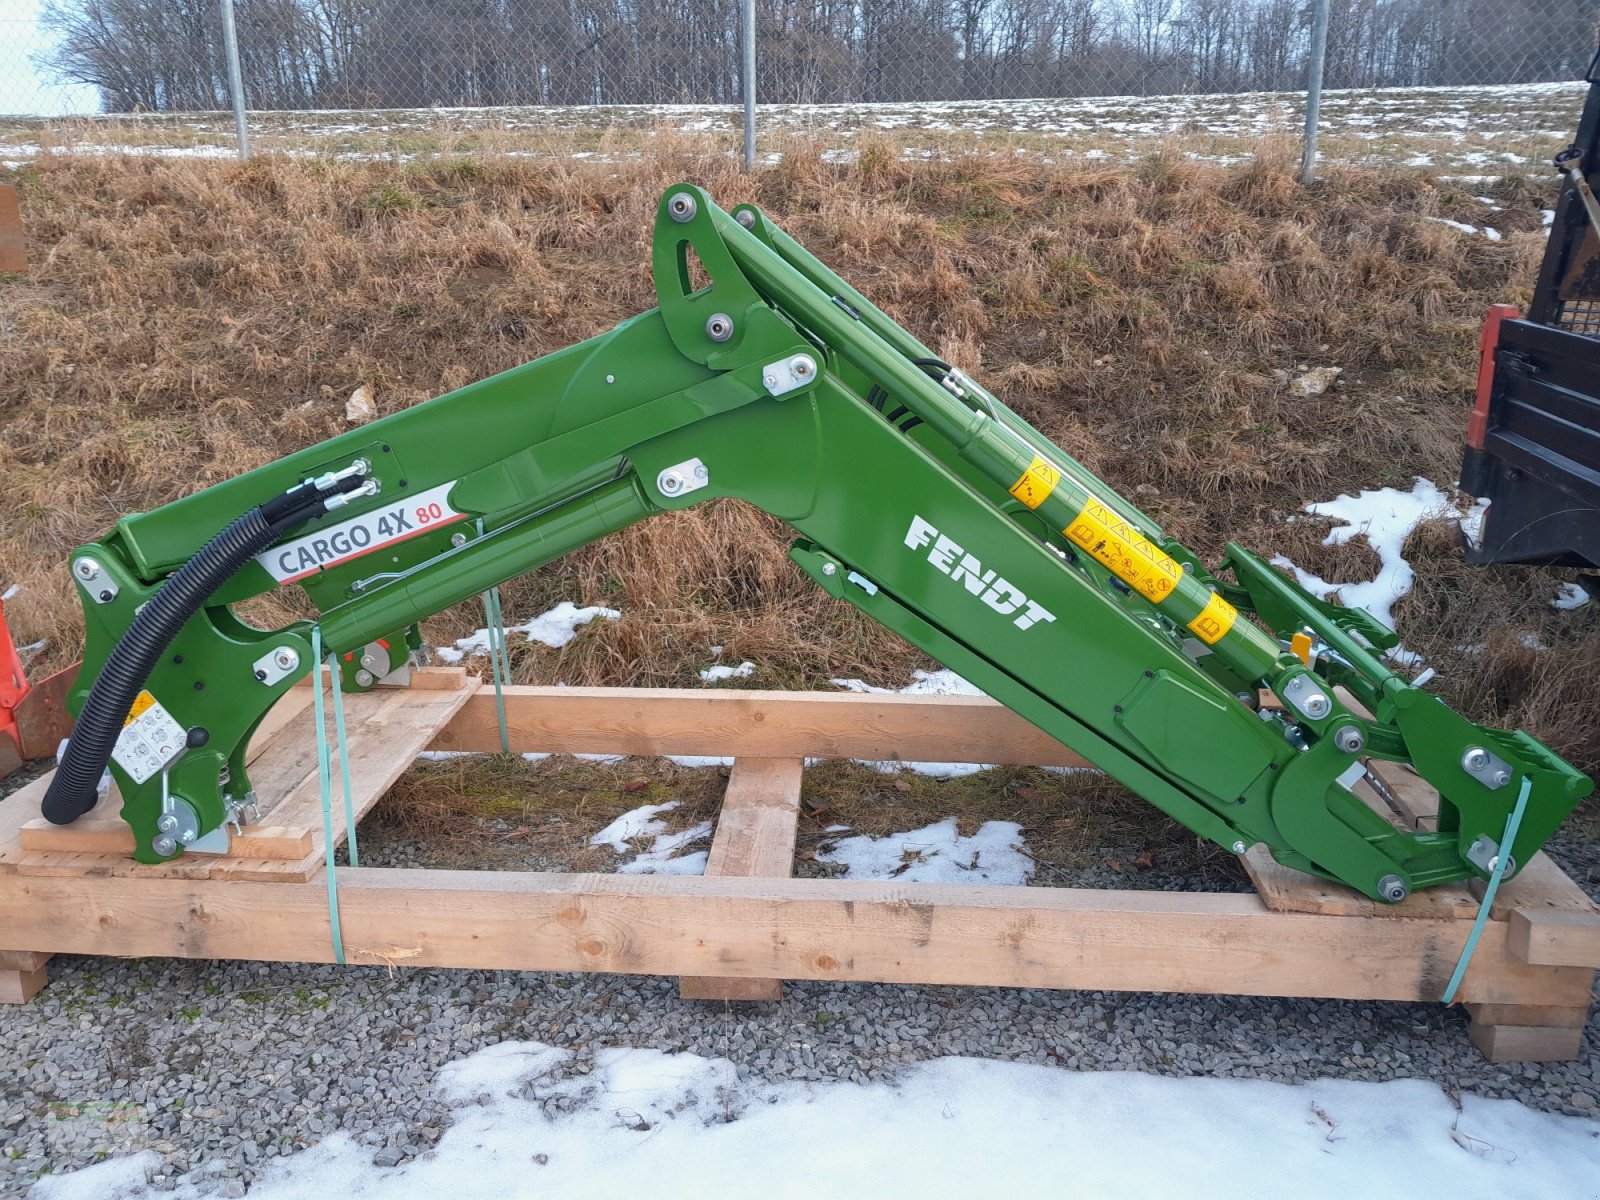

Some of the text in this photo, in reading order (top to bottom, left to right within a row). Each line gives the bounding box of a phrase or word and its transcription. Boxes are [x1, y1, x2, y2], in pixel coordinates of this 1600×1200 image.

[279, 502, 442, 574] CARGO 4X 80
[904, 514, 1057, 631] FENDT
